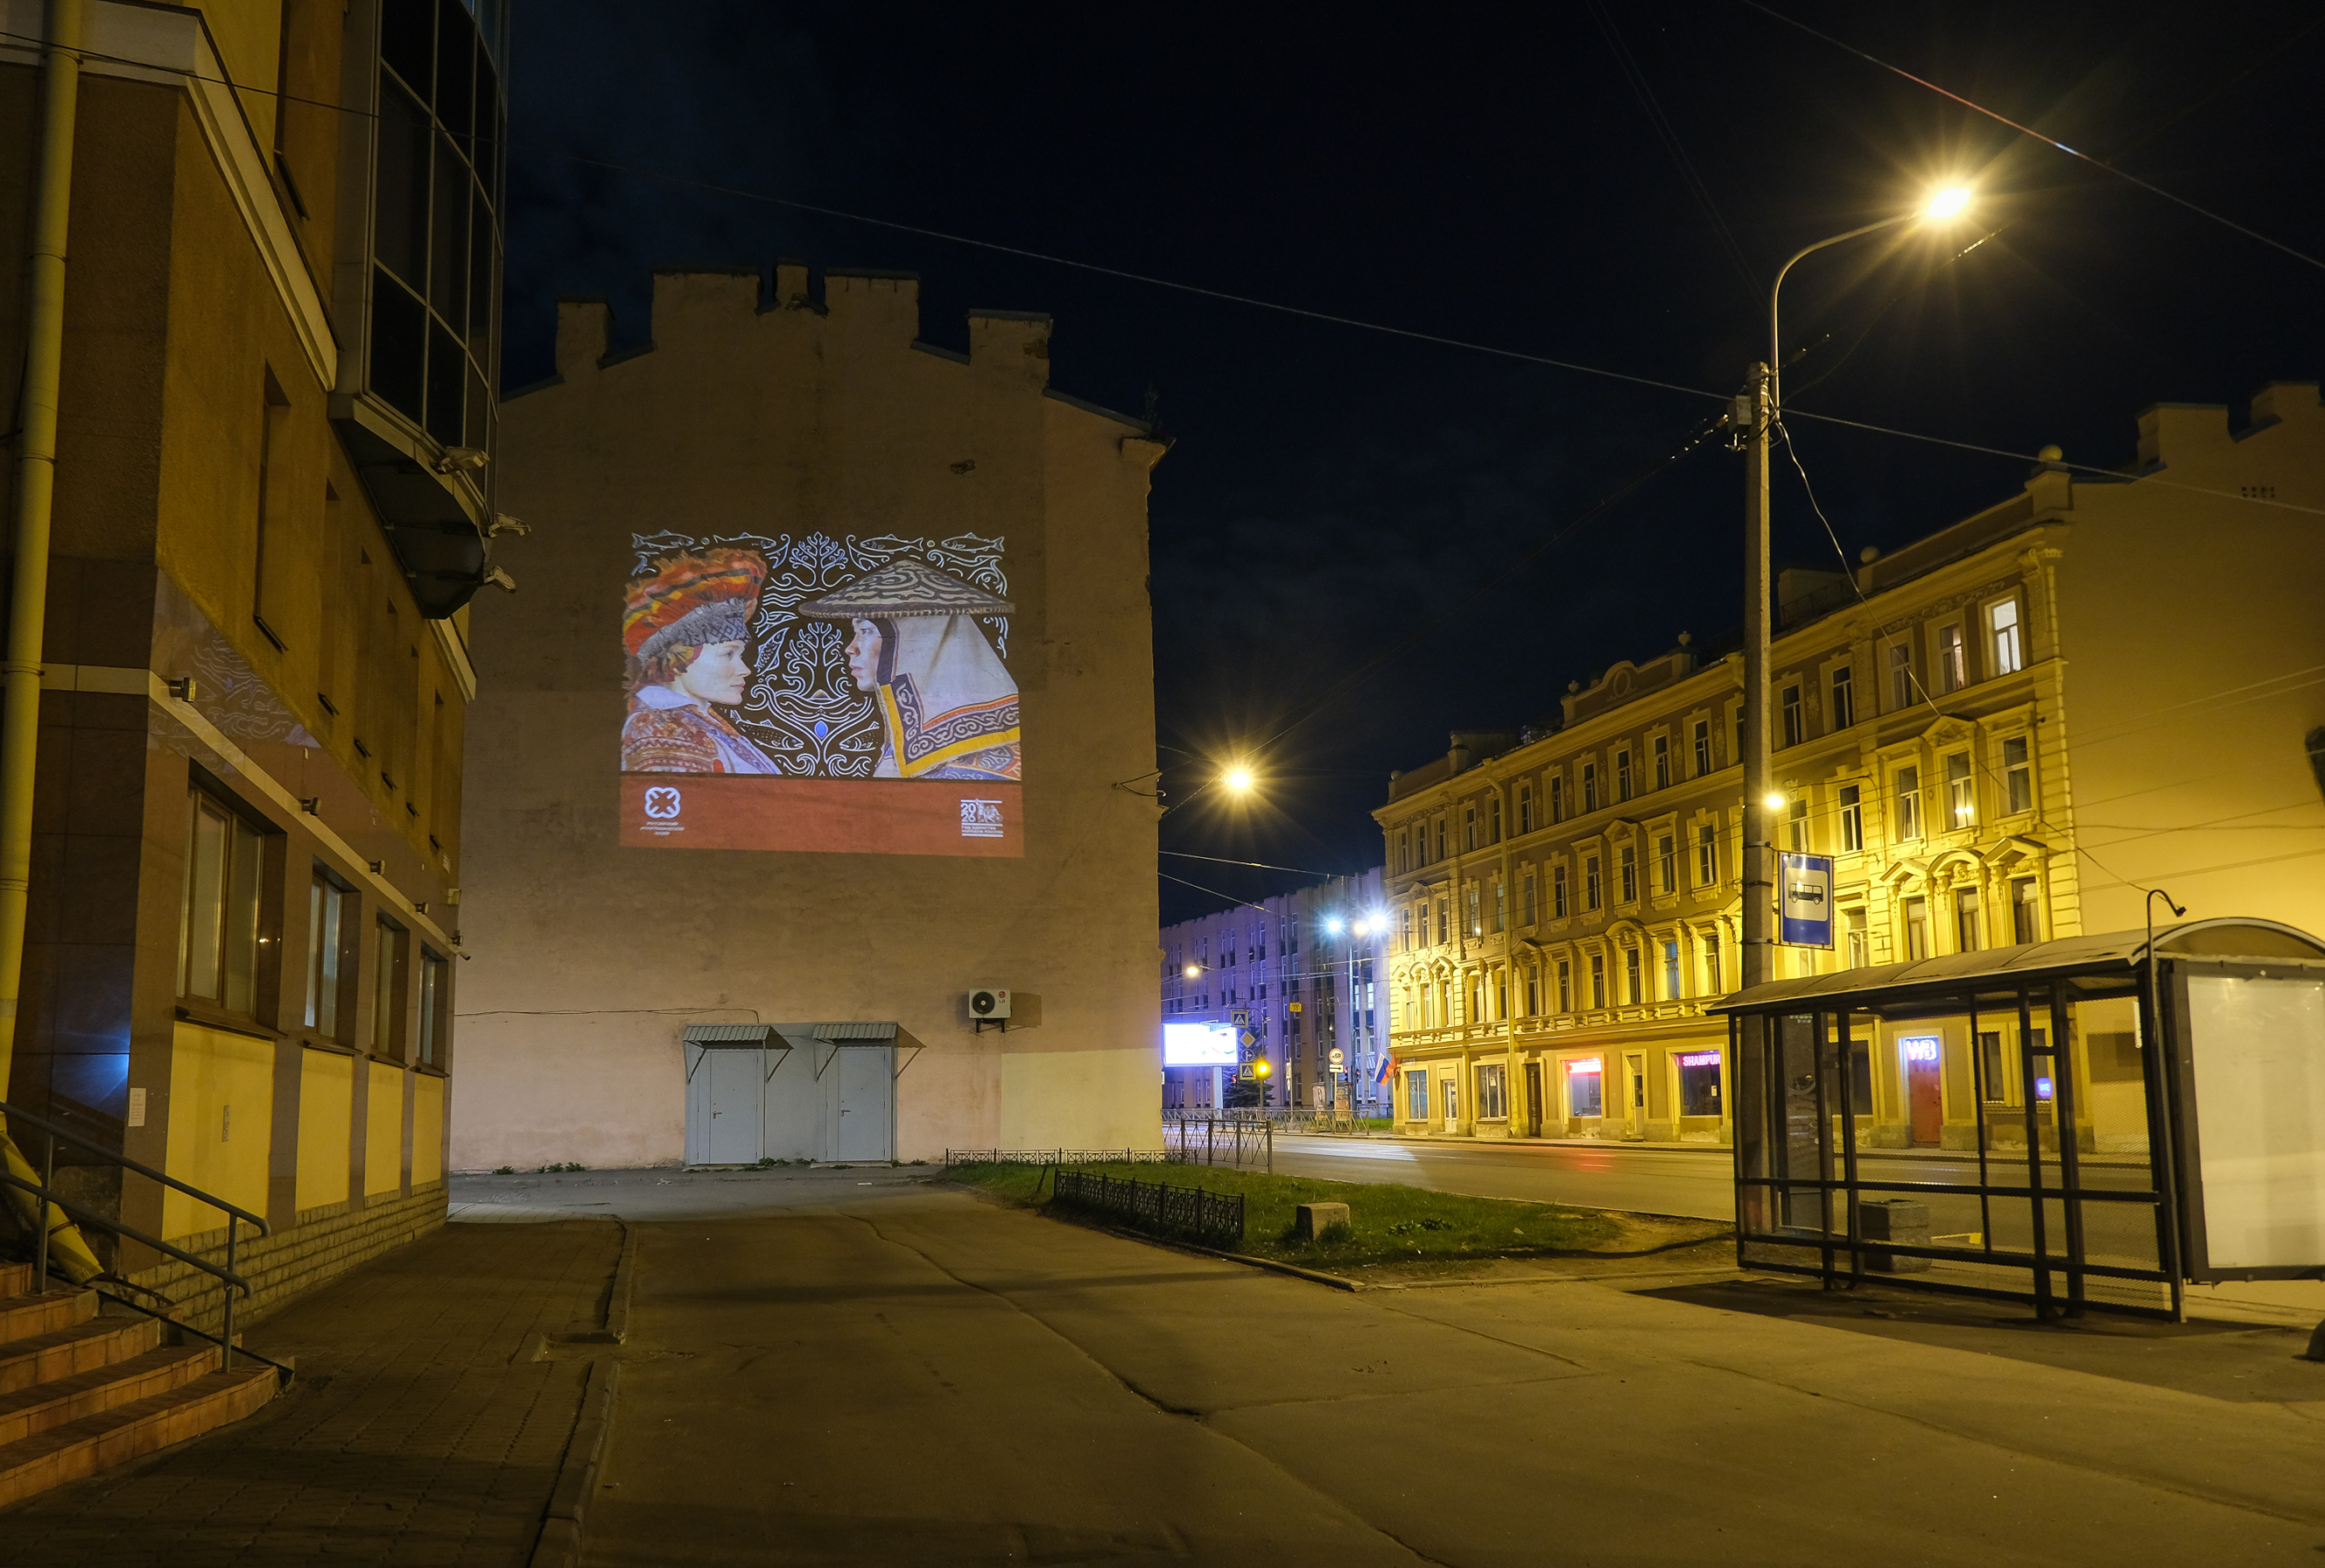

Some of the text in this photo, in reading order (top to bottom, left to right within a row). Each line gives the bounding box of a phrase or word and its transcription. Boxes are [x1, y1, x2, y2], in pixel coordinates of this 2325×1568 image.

[960, 802, 977, 813] 20
[960, 812, 977, 822] 26
[1905, 1039, 1936, 1061] WB
[1683, 1054, 1720, 1066] SHAMPUR
